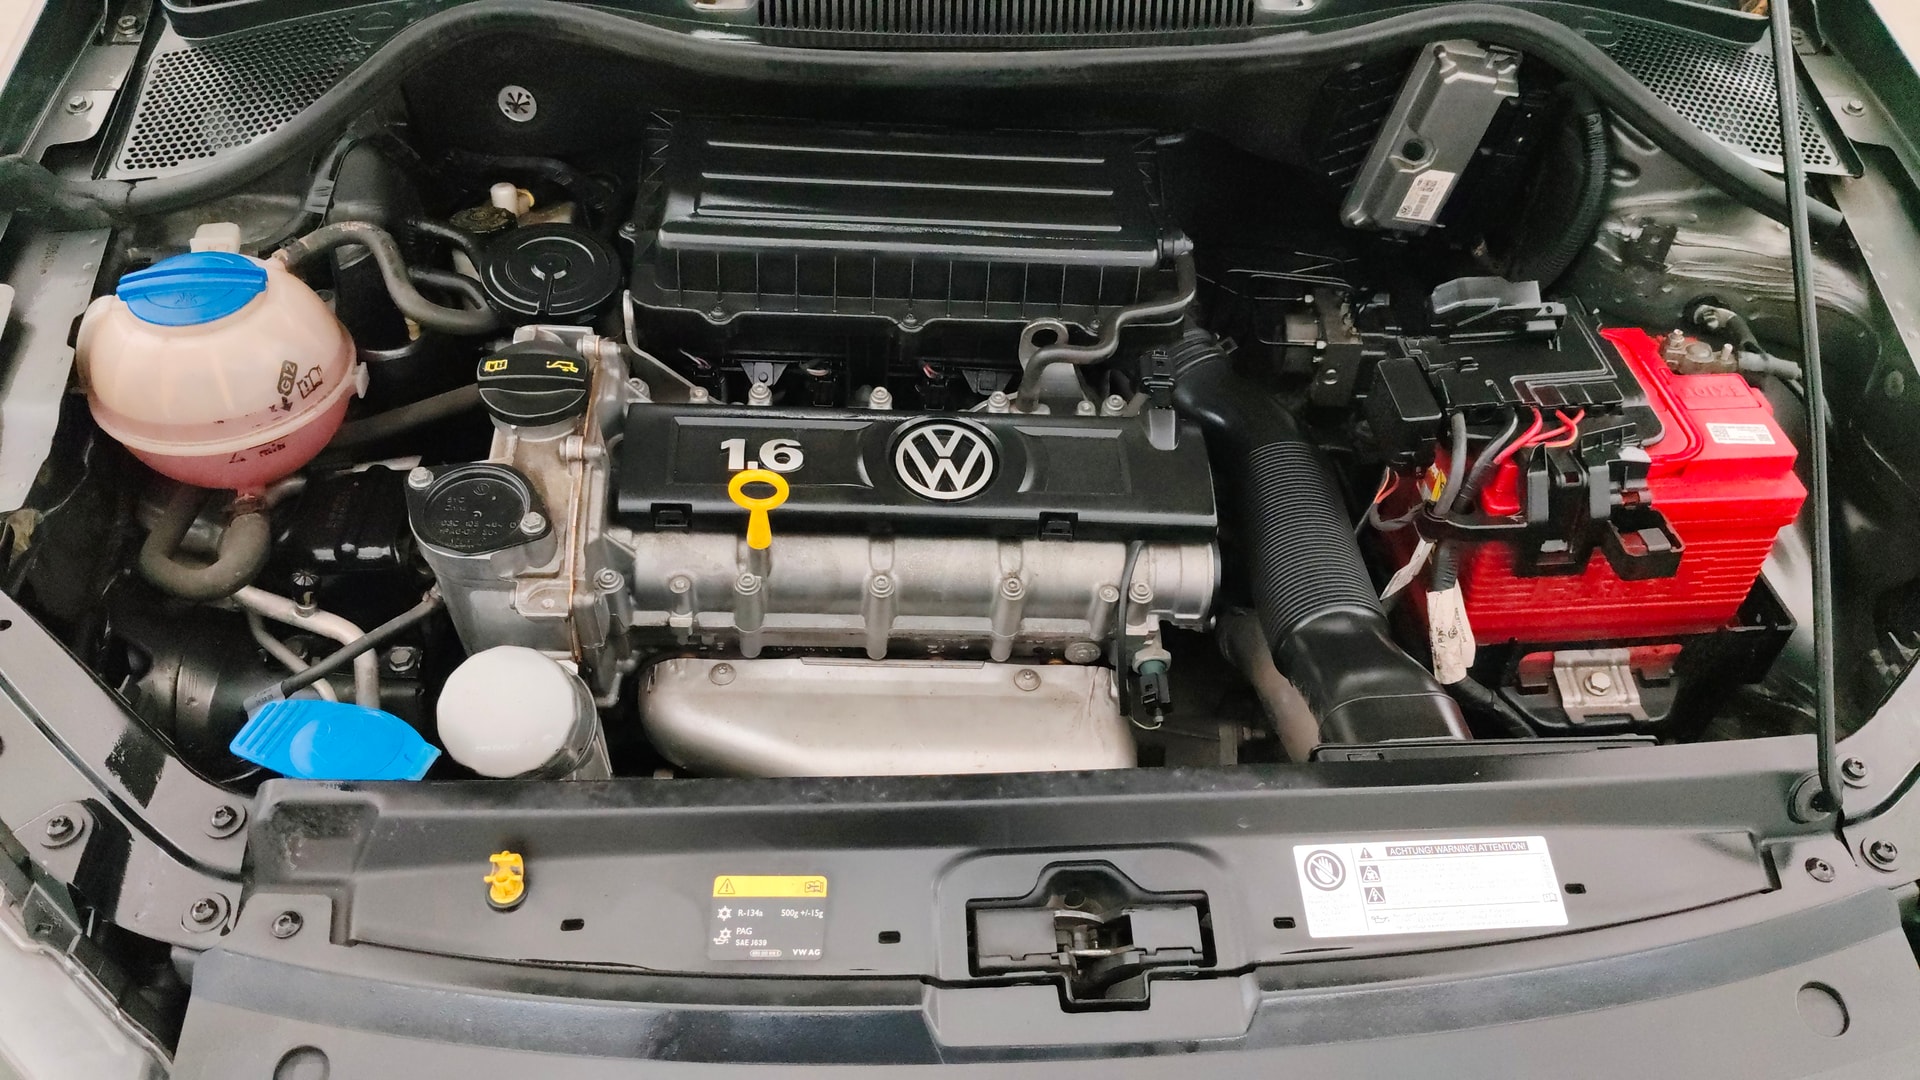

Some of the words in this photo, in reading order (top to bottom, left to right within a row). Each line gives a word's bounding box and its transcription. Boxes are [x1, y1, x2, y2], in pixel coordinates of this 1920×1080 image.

[280, 363, 296, 392] G12
[720, 438, 804, 473] 1.6
[1389, 846, 1434, 856] ACHTUNG!
[1434, 844, 1478, 854] WARNING!
[1478, 842, 1527, 852] ATTENTION!
[737, 908, 763, 917] R-134a
[781, 908, 799, 919] 500g
[736, 927, 753, 935] PAG
[792, 948, 807, 956] VW
[808, 948, 821, 956] AG
